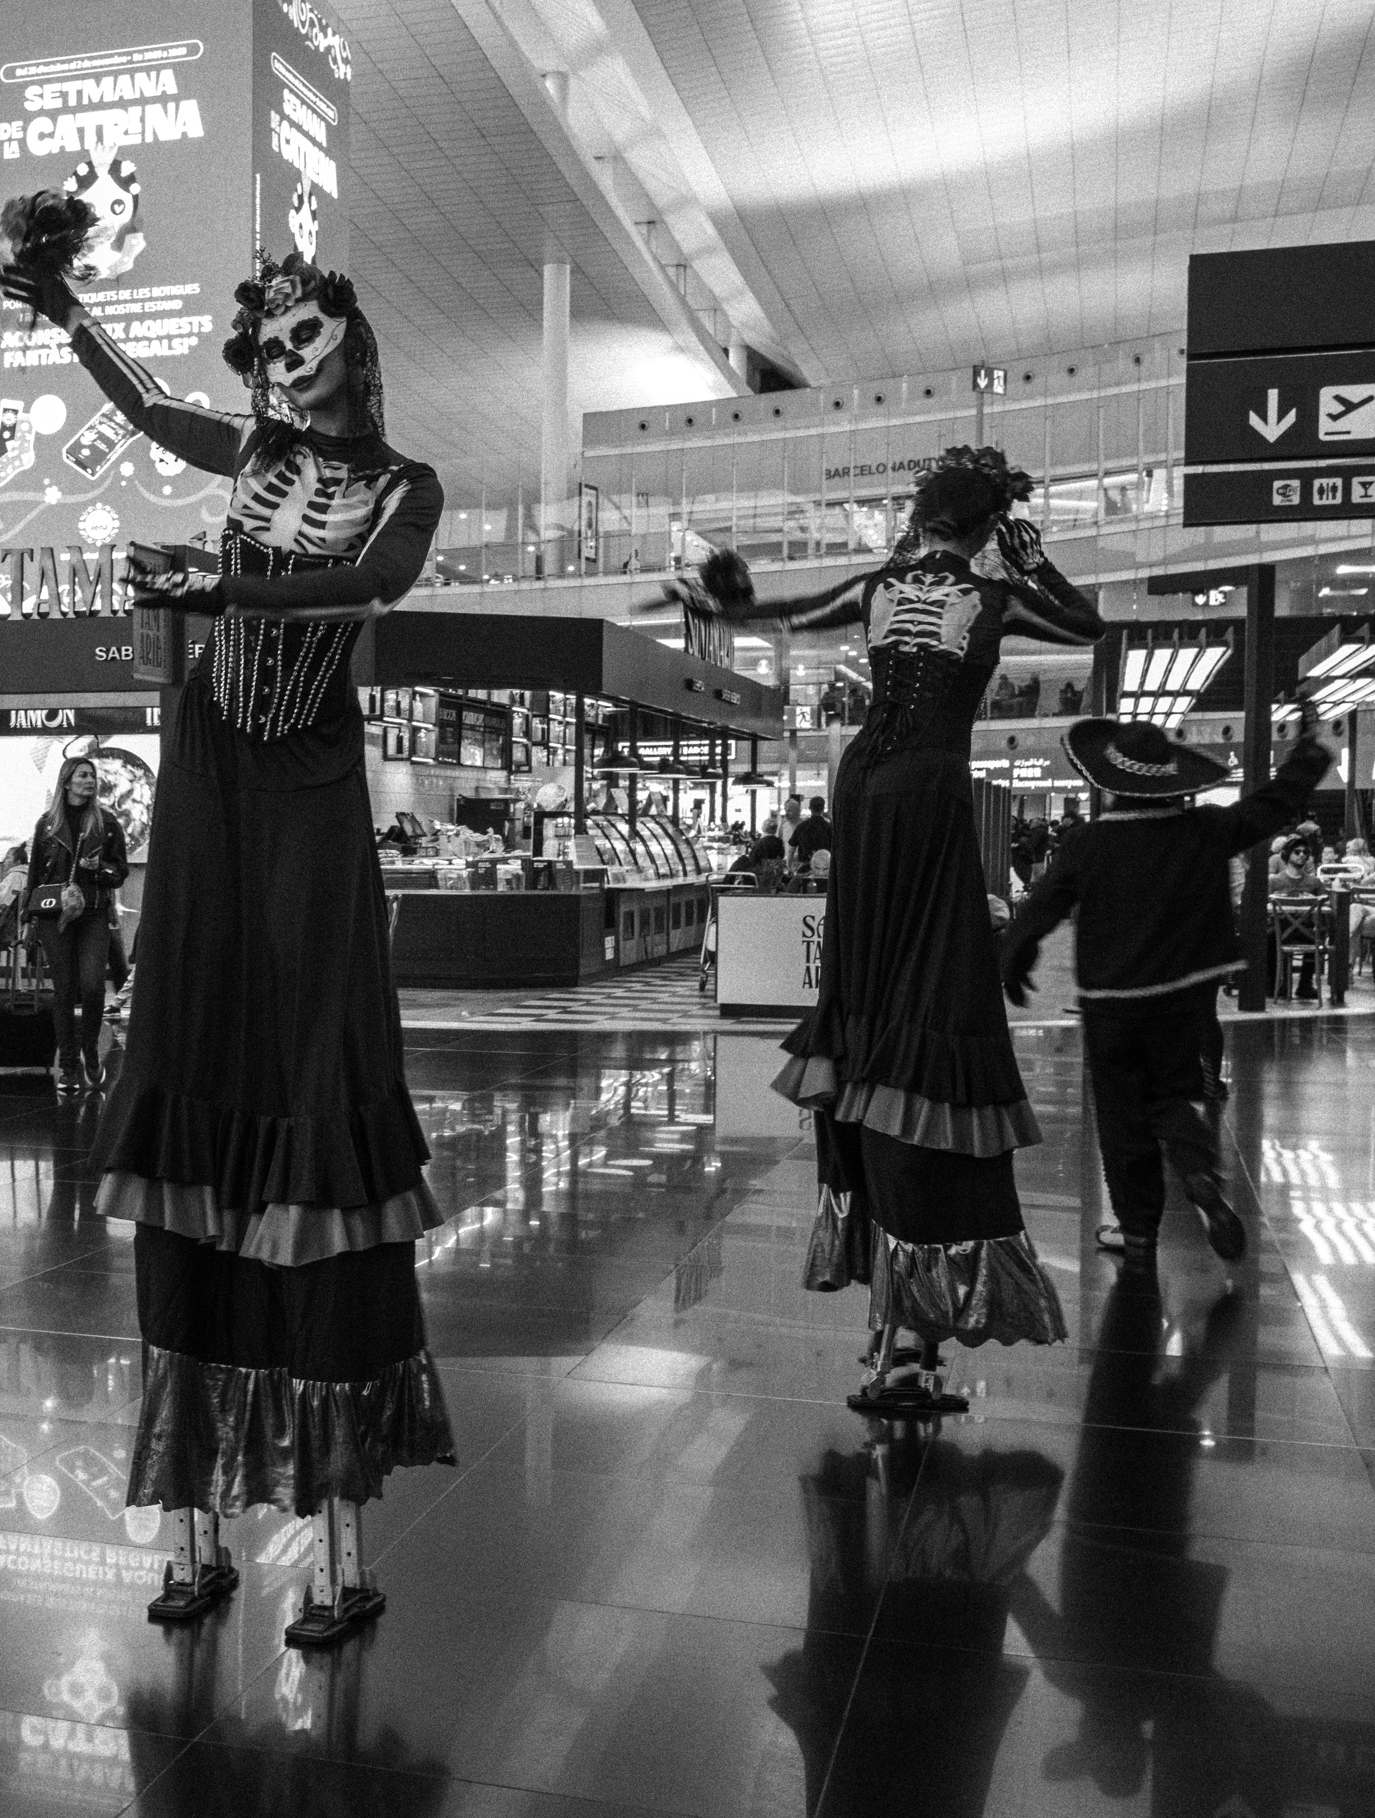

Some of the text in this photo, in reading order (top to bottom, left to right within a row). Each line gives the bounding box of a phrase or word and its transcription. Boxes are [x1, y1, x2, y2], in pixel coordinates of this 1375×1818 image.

[24, 69, 178, 111] SETMANA
[0, 121, 24, 140] DE
[26, 99, 204, 156] CATRINA
[3, 141, 20, 159] LA
[118, 289, 132, 300] DE
[133, 287, 151, 299] LES
[129, 315, 213, 338] AQUESTS
